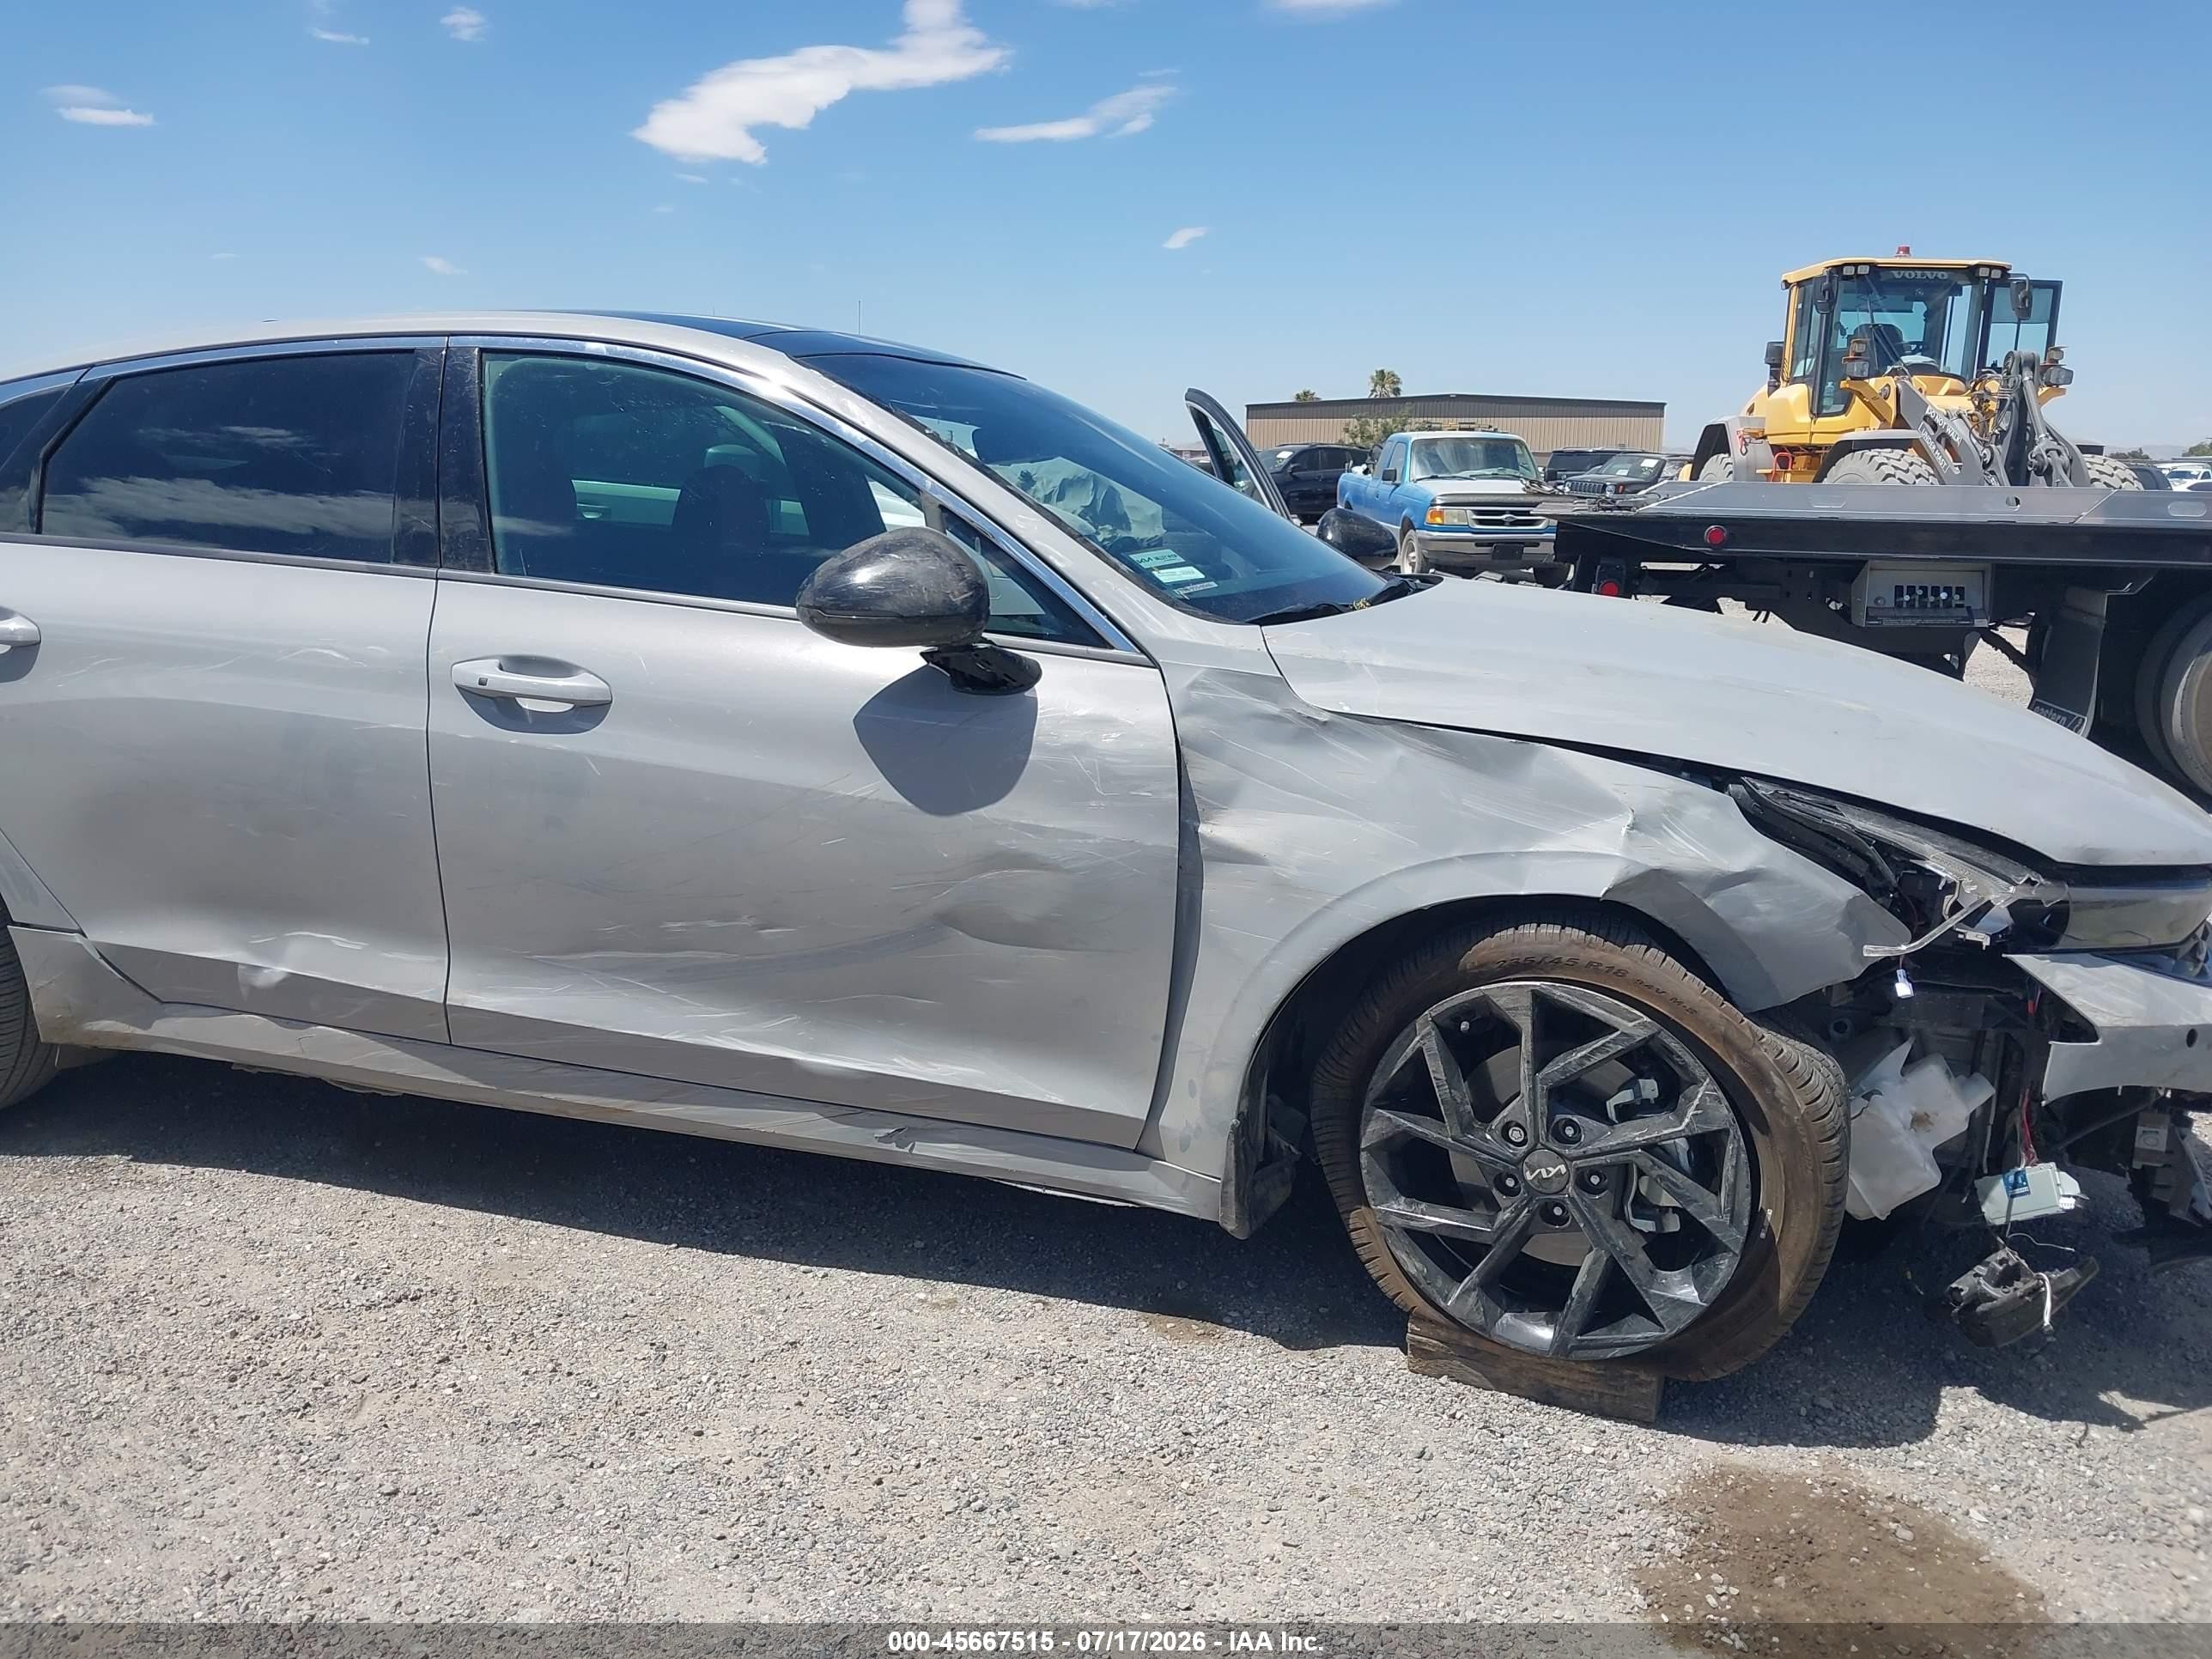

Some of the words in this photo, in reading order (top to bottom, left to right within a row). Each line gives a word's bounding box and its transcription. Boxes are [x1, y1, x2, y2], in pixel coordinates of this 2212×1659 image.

[1891, 270, 1948, 279] VOLVO
[1935, 414, 1947, 428] NOT
[1946, 425, 1962, 443] WALK
[1921, 428, 1936, 451] UNDER
[1934, 449, 1948, 468] MAST
[1496, 956, 1580, 969] 235/45
[1585, 960, 1629, 978] R18
